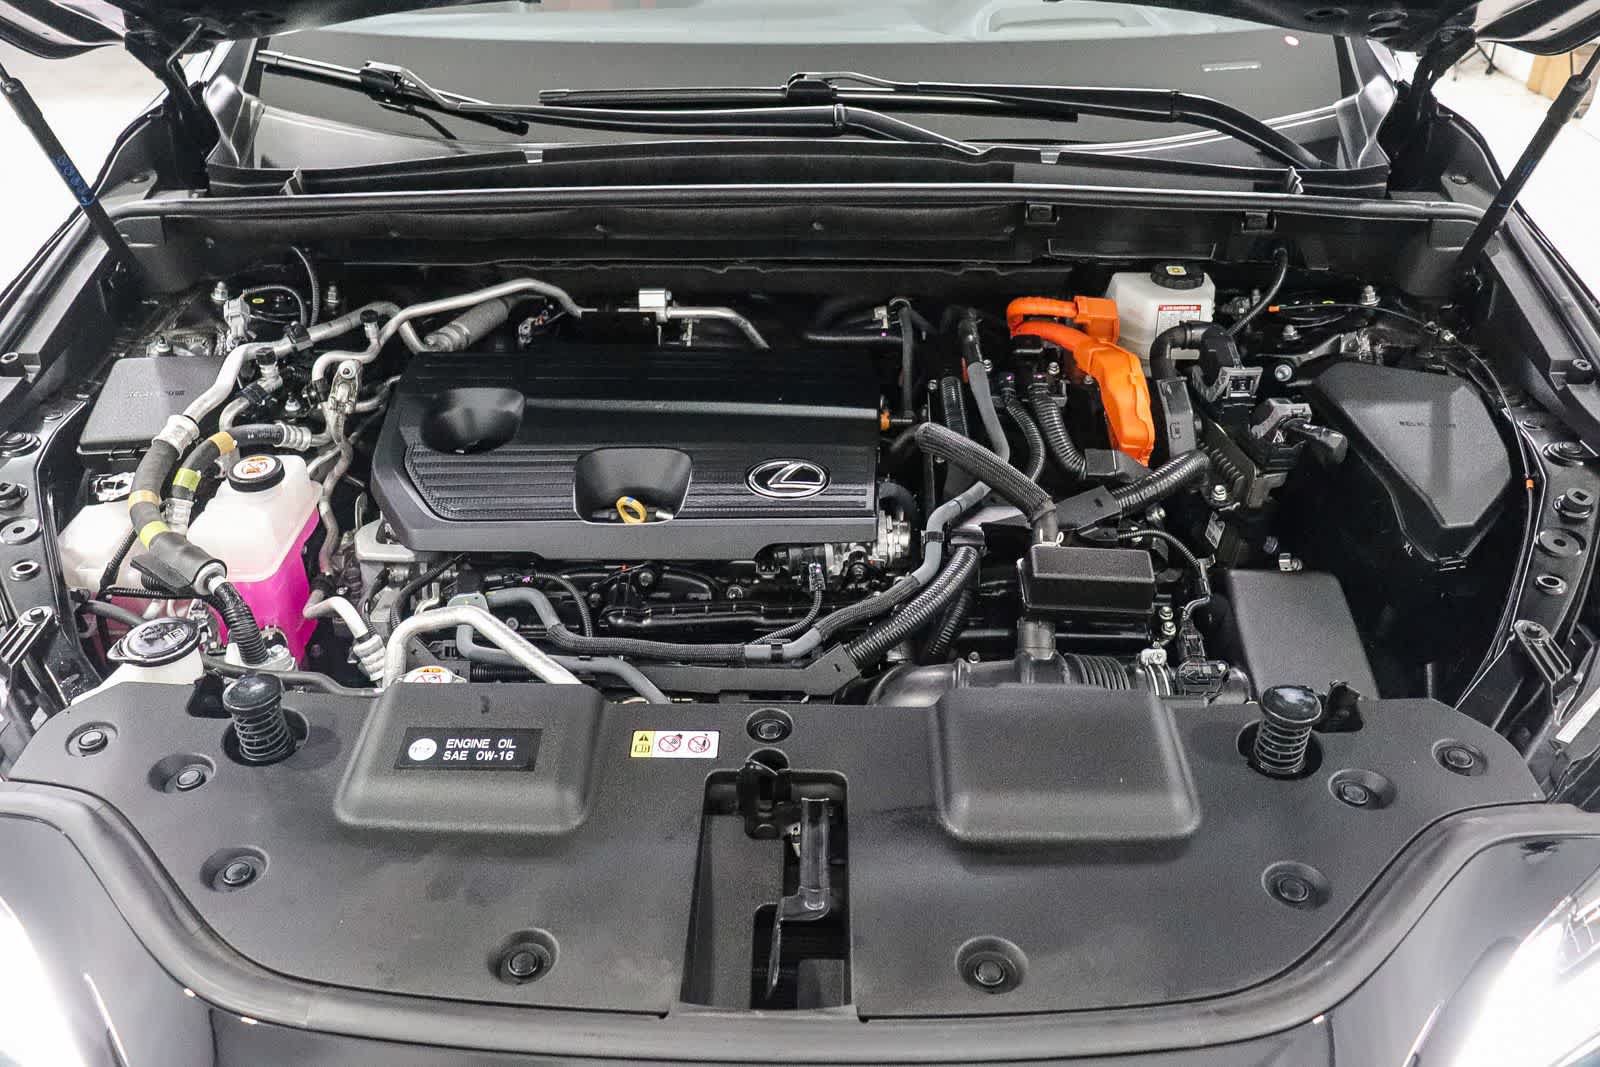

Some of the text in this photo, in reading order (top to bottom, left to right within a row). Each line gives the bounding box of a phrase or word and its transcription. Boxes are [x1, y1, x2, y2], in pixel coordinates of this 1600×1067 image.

[445, 738, 517, 749] ENGINE OIL
[442, 750, 469, 761] SAE
[475, 750, 515, 761] 0W-16
